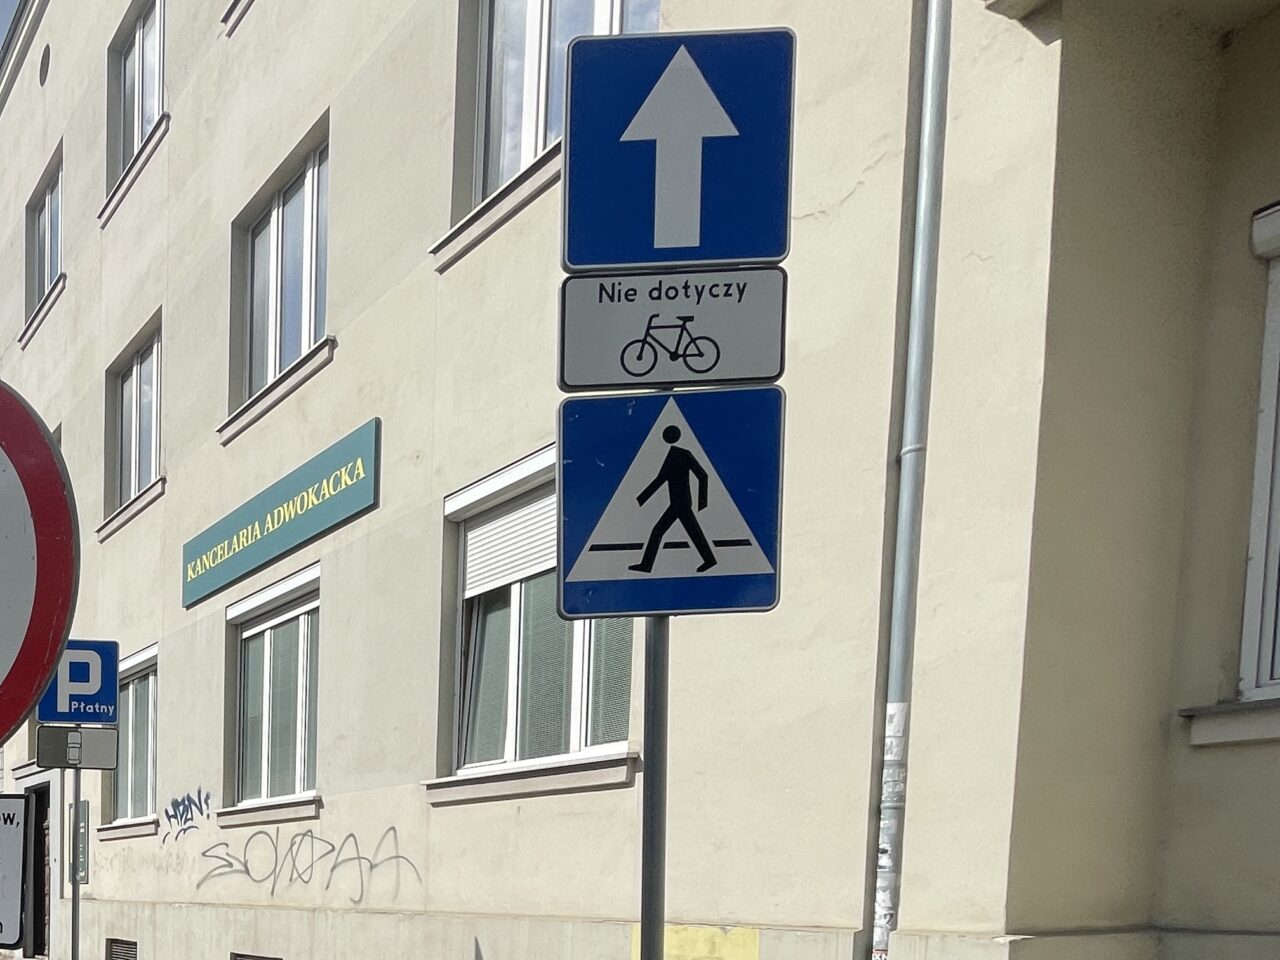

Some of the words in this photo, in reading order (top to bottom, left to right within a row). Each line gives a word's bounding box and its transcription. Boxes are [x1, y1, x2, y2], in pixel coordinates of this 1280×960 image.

[598, 281, 638, 303] Nie
[648, 279, 748, 305] dotyczy
[186, 520, 261, 582] KANCELARIA
[263, 457, 366, 536] ADWOKACKA
[57, 649, 102, 713] P
[71, 701, 115, 717] Płatny
